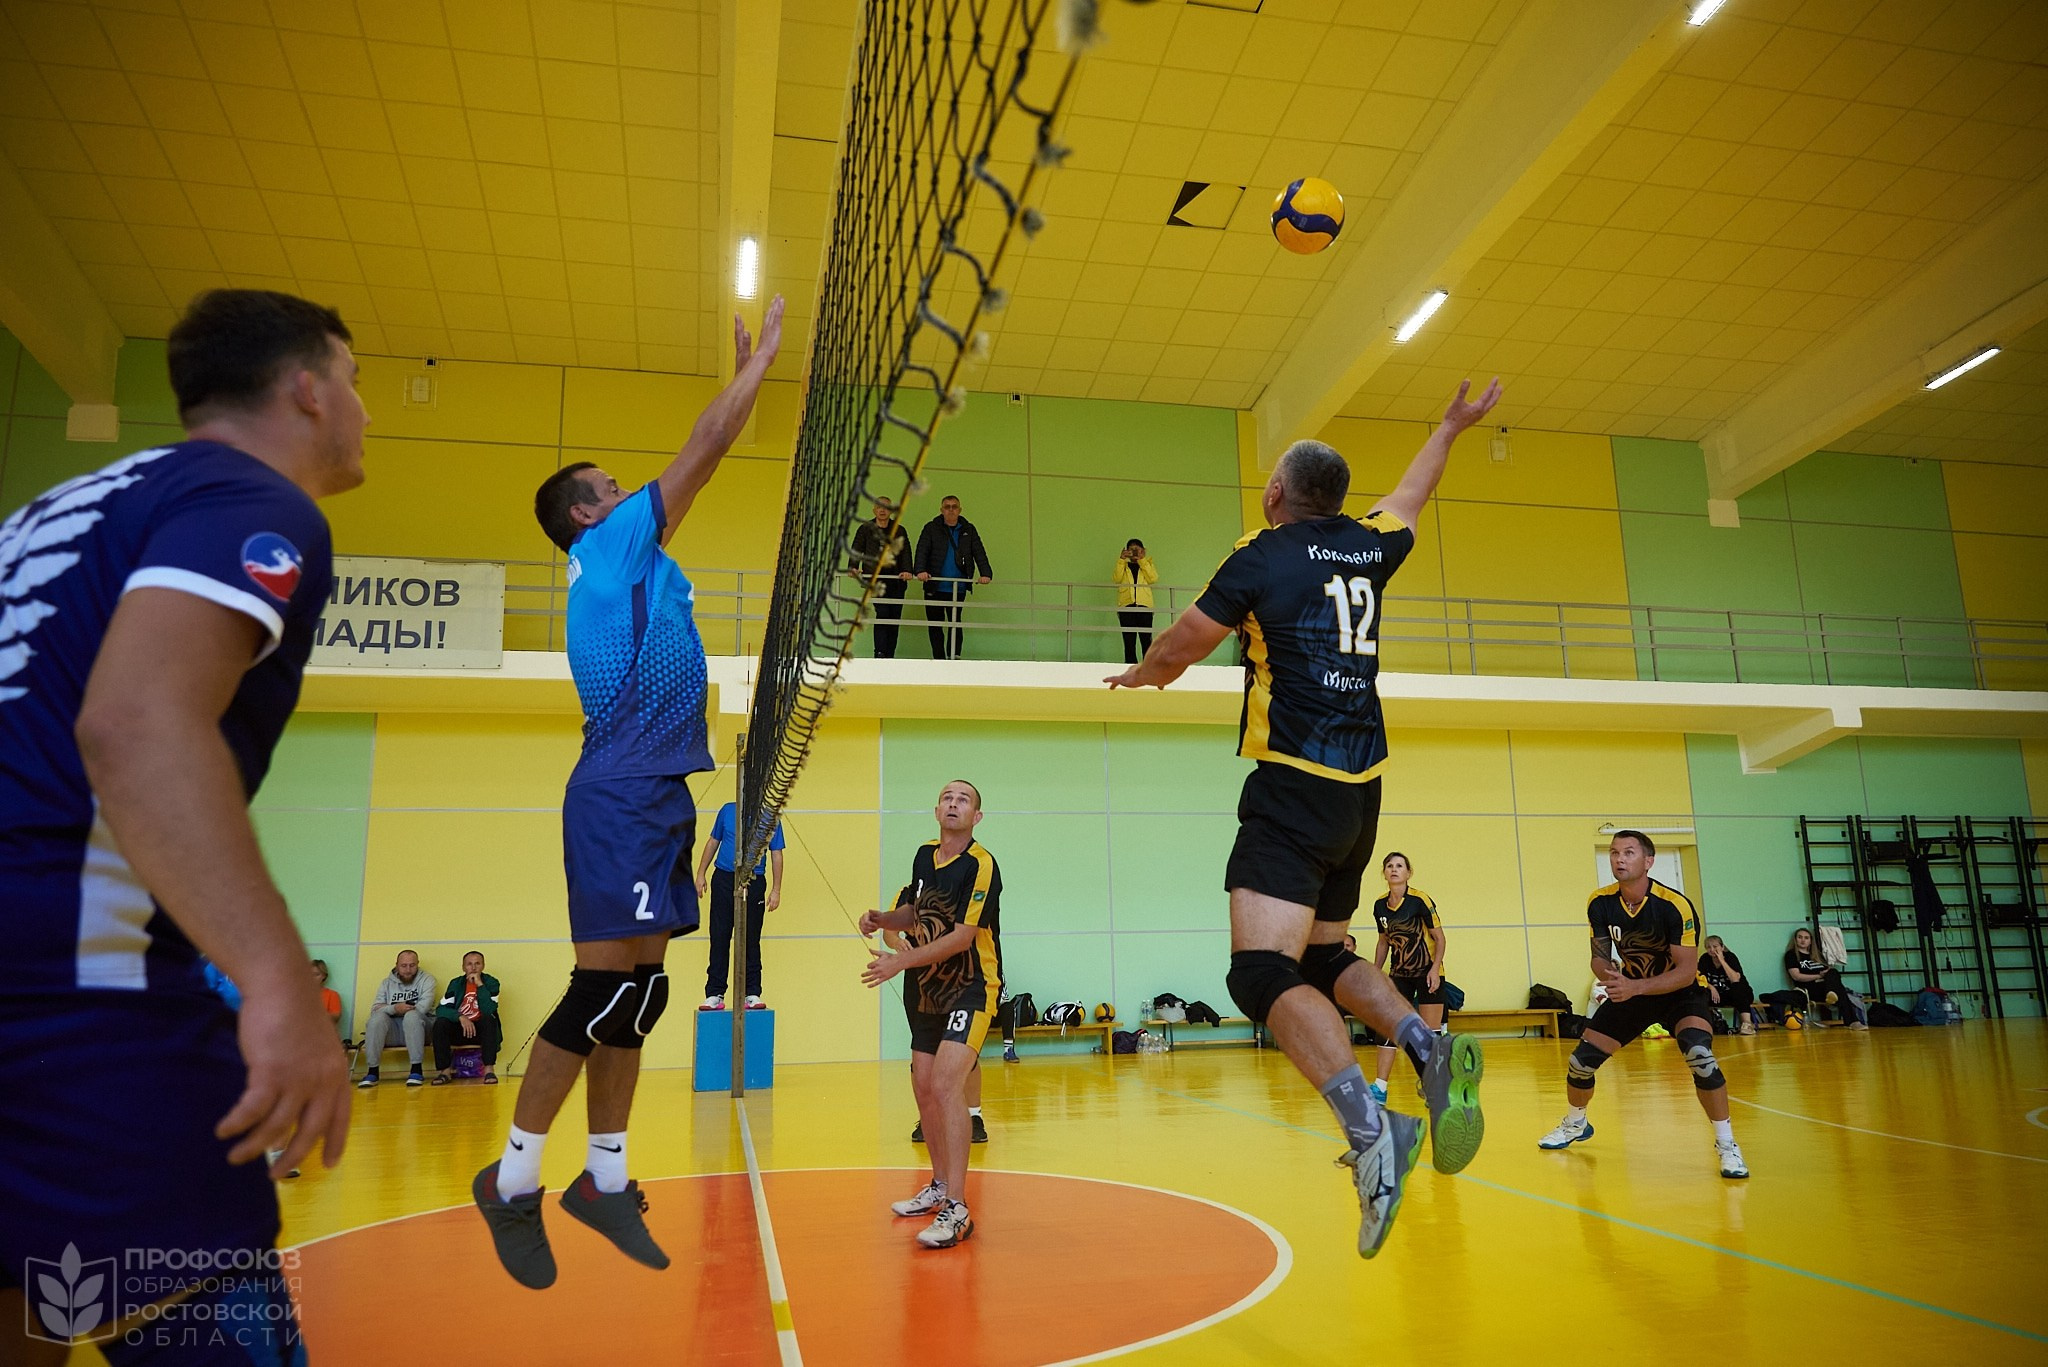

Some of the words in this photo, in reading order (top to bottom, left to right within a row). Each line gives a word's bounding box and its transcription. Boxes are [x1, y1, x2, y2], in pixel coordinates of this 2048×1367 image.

[1323, 574, 1377, 656] 12
[633, 881, 655, 920] 2
[1607, 924, 1621, 941] 10
[946, 1009, 969, 1032] 13
